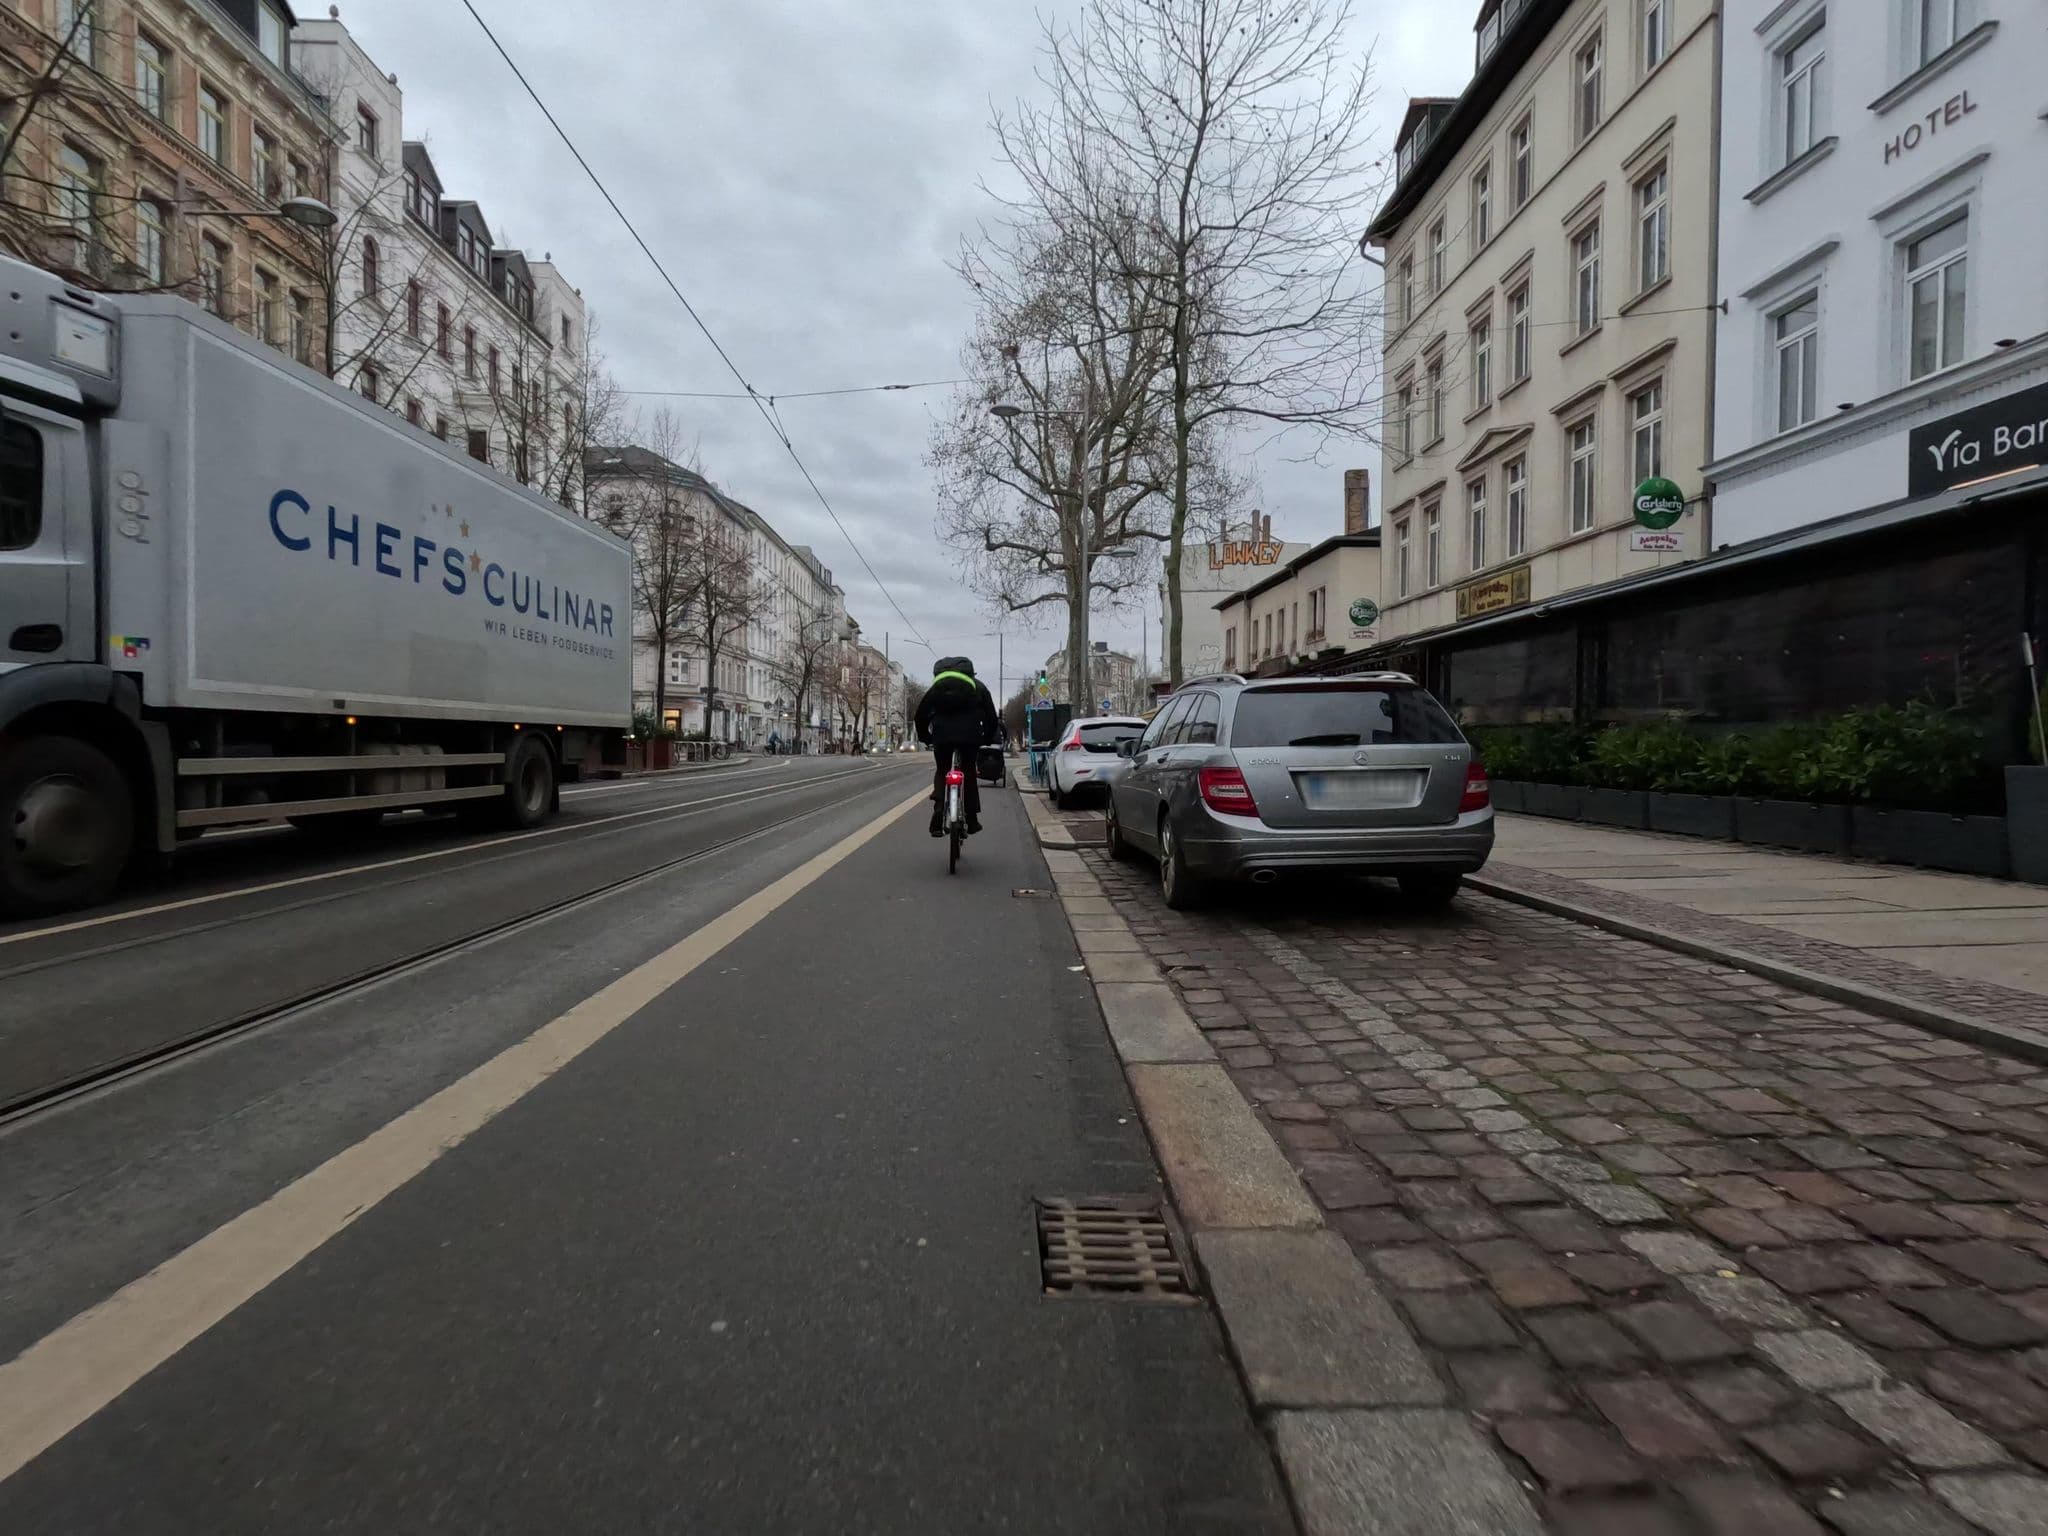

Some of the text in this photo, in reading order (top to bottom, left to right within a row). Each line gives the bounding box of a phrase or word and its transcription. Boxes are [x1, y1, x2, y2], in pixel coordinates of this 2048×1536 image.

[1884, 90, 1977, 165] HOTEL
[1928, 429, 1980, 472] Via
[1637, 495, 1682, 513] Carlsberg
[269, 489, 613, 638] CHEFS CULINAR
[1209, 541, 1284, 570] LOWKEY
[485, 619, 506, 635] WIR
[512, 627, 547, 645] LEBEN
